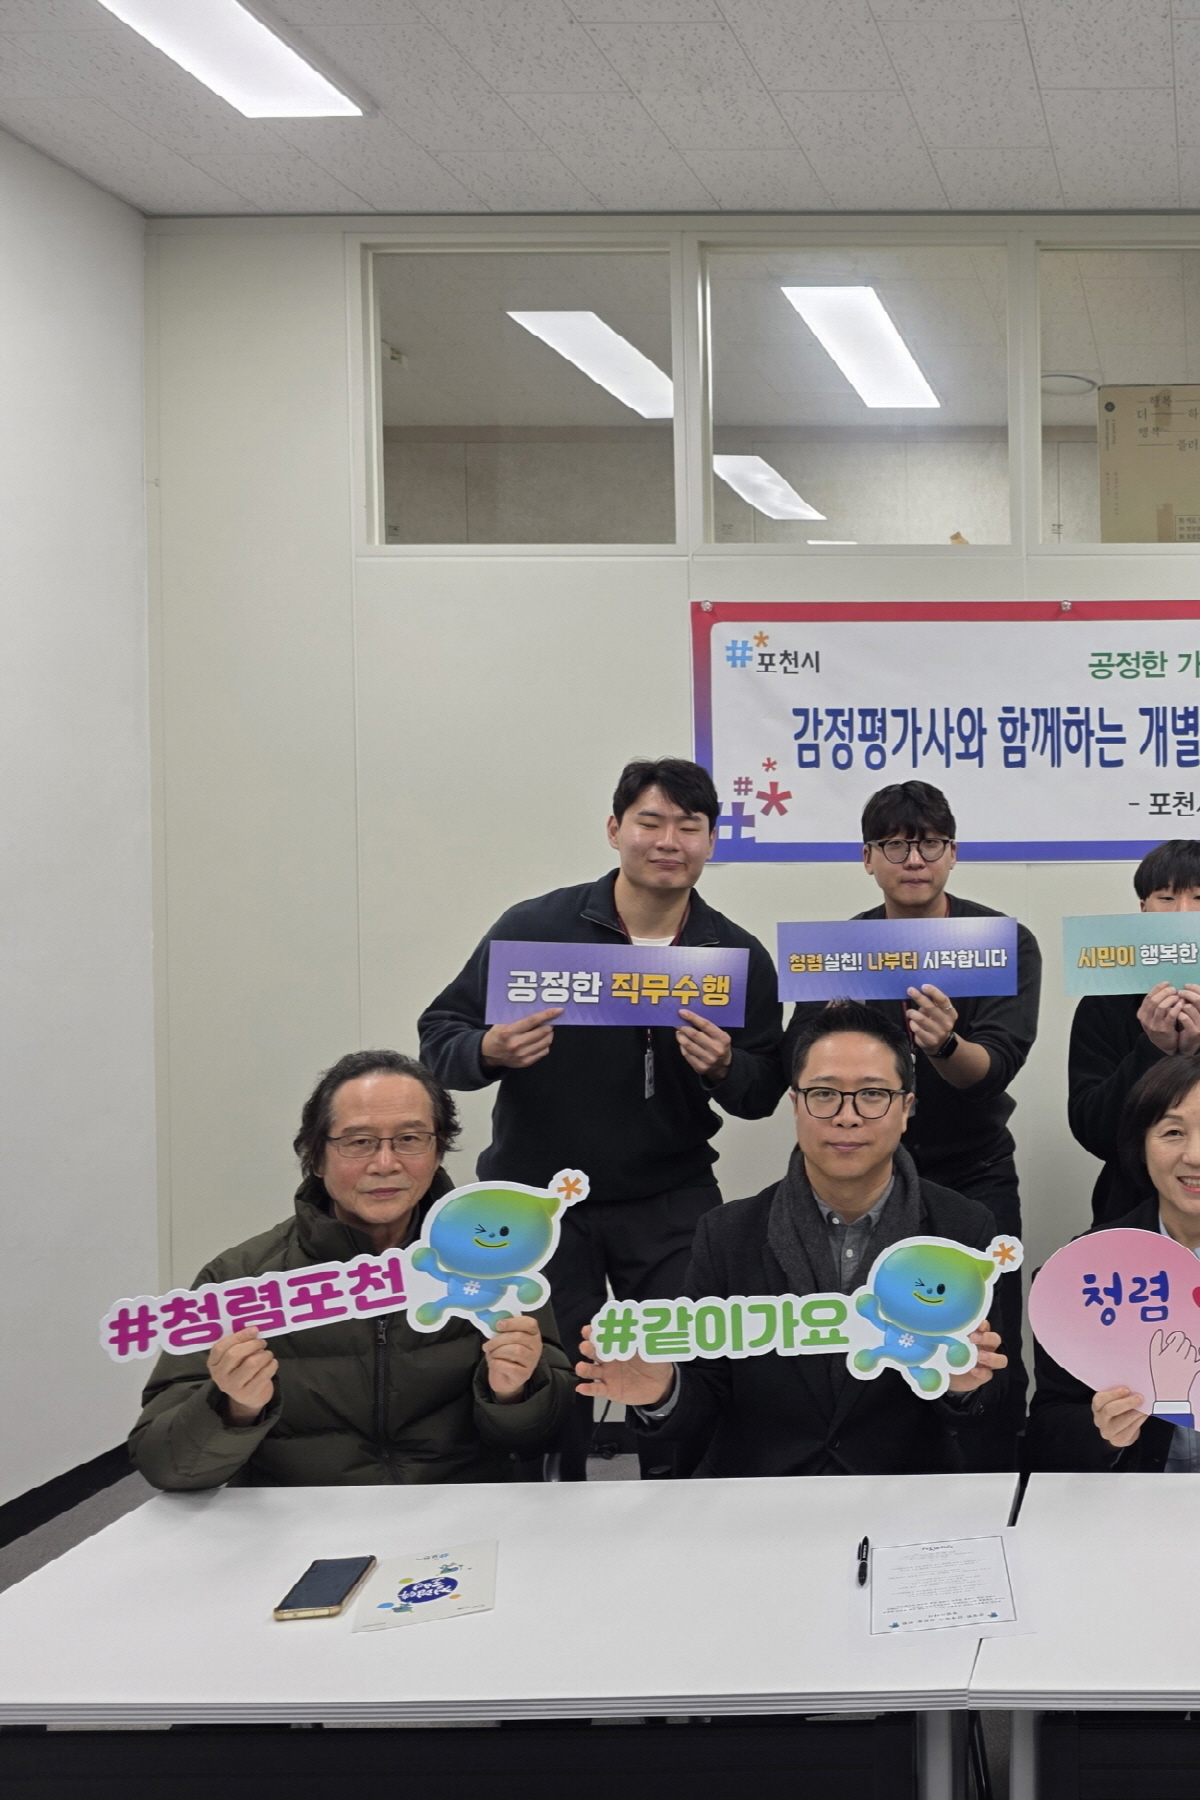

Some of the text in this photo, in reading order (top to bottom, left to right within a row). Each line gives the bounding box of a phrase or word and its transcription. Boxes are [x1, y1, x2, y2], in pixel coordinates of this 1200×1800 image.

[756, 649, 821, 674] 포천시
[1088, 650, 1168, 679] 공정한
[792, 706, 987, 771] 감정평가사와
[998, 705, 1127, 769] 함께하는
[788, 948, 1008, 973] 청렴실천! 나부터 시작합니다
[1077, 945, 1135, 968] 시민이
[1139, 943, 1198, 966] 행복한
[507, 970, 731, 1008] 공정한 직무수행
[108, 1256, 408, 1357] #청렴포천
[1082, 1270, 1170, 1326] 청렴
[596, 1298, 850, 1355] #같이가요
